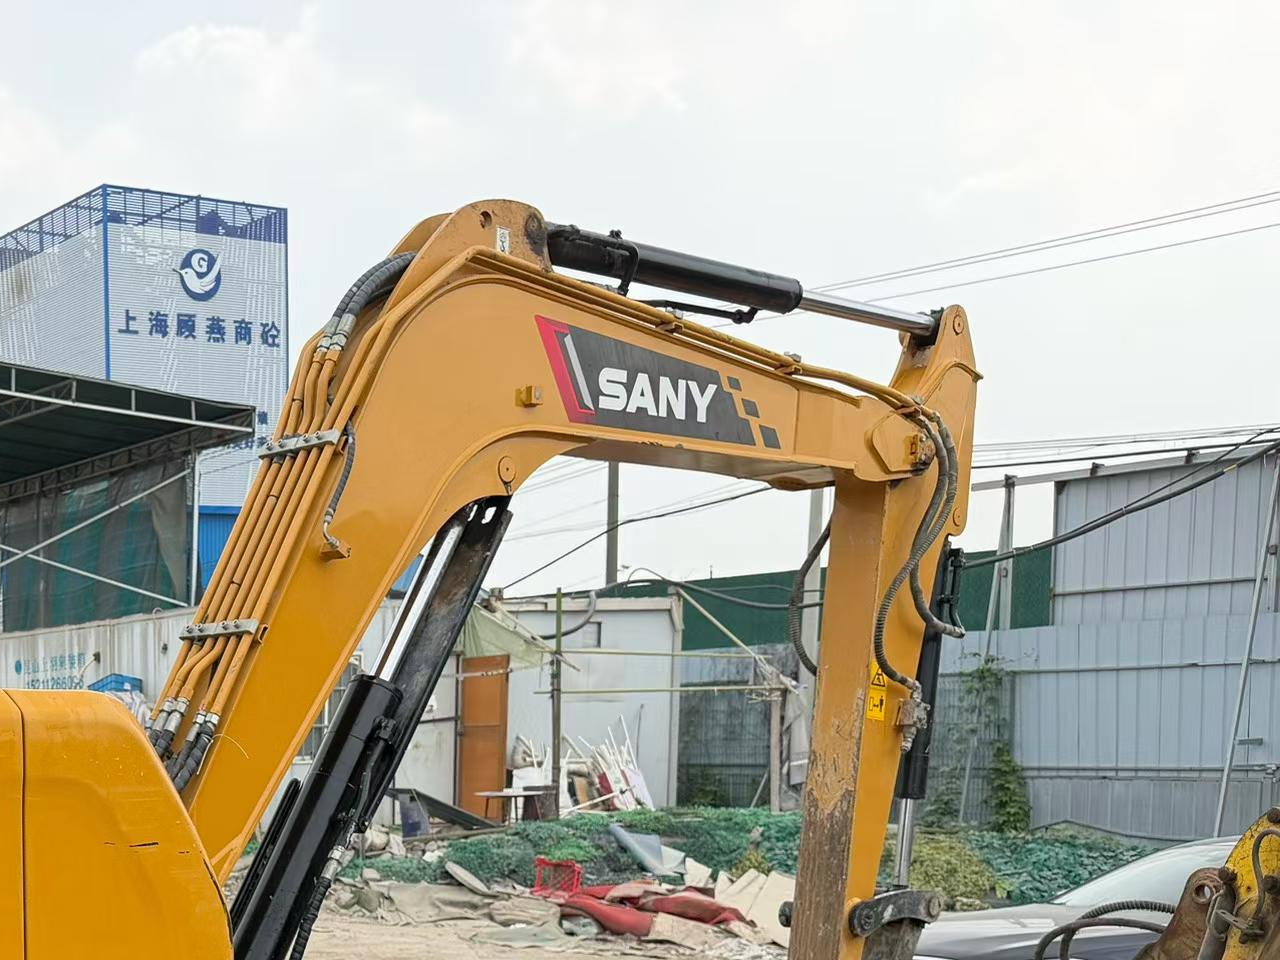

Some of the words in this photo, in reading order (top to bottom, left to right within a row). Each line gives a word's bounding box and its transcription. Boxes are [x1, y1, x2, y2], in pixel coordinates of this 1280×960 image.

[117, 308, 281, 348] 上海顾燕商砼
[598, 367, 718, 424] SANY
